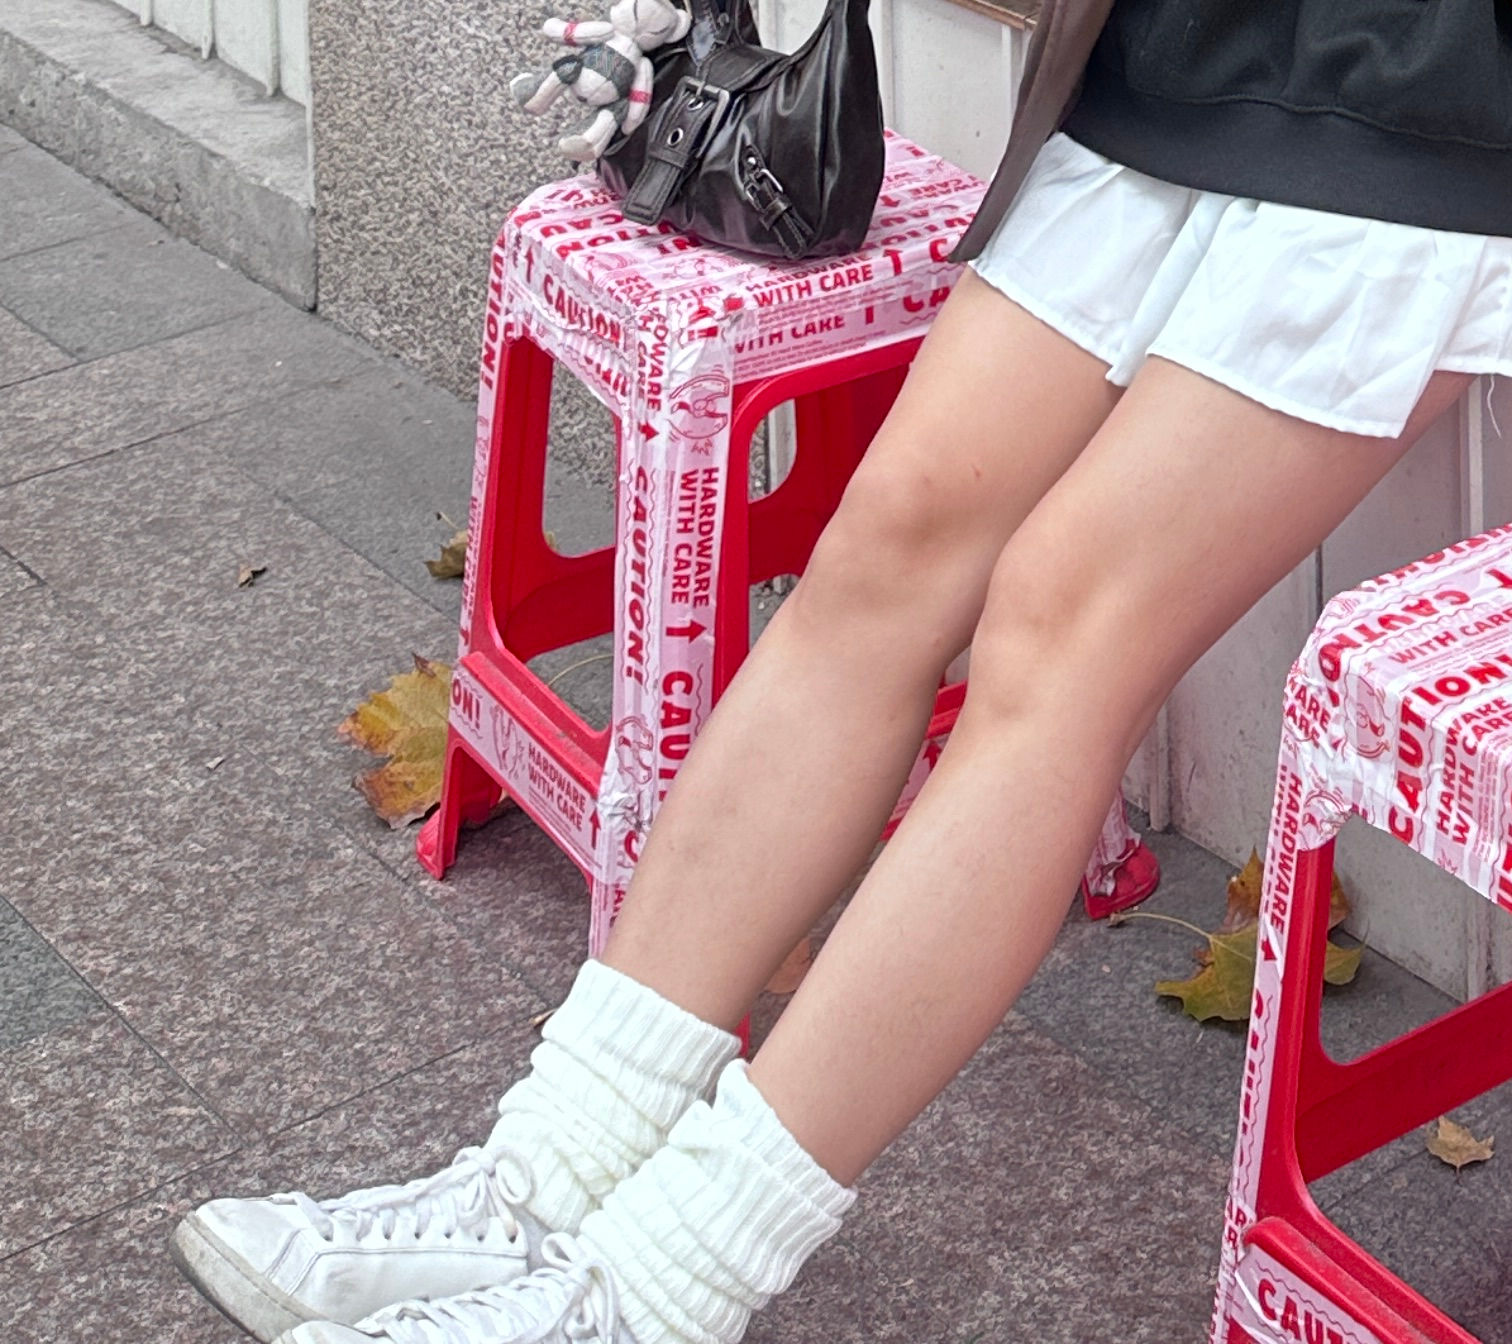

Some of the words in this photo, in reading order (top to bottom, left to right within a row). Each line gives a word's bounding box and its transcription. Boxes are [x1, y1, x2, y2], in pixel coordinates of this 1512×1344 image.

[754, 280, 812, 308] WITH
[820, 264, 875, 293] CARE
[676, 469, 699, 534] WITH
[693, 467, 719, 609] HARDWARE
[626, 465, 648, 686] CAUTION!
[671, 543, 693, 605] CARE
[1388, 629, 1456, 665] WITH
[528, 742, 586, 814] HARDWARE
[528, 764, 554, 802] WITH
[556, 793, 583, 831] CARE
[1270, 772, 1303, 935] HARDWARE
